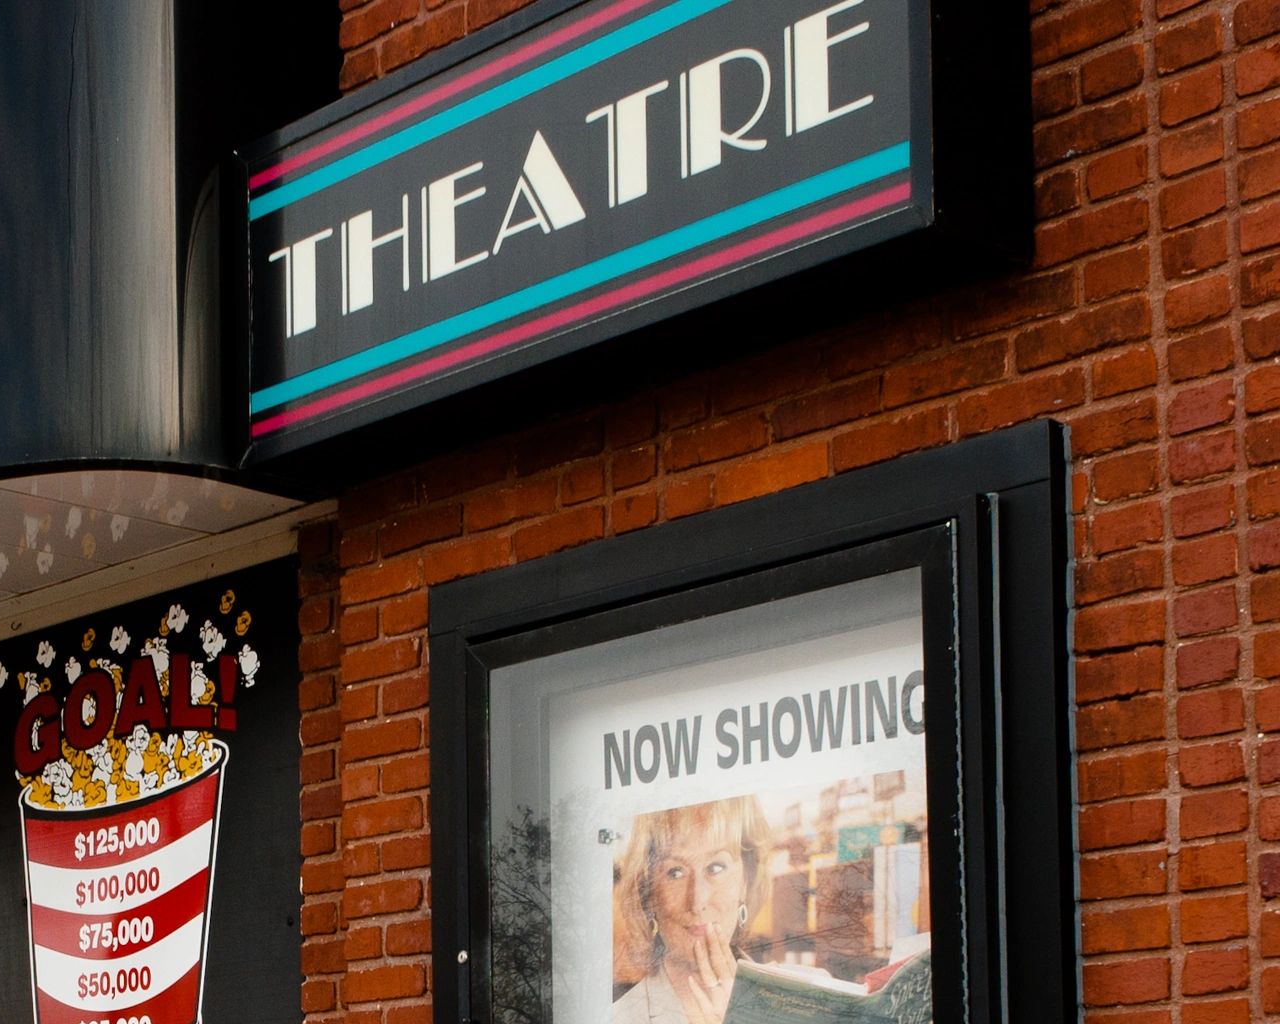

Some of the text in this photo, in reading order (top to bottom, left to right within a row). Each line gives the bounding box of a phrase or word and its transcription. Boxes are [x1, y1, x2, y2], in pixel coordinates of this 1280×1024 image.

[269, 0, 874, 338] THEATRE
[13, 654, 238, 776] GOAL!
[602, 669, 925, 790] NOW SHOWING
[74, 818, 160, 860] $125,000
[75, 866, 160, 907] $100,000
[79, 916, 154, 951] $75,000
[77, 966, 152, 1000] $50,000
